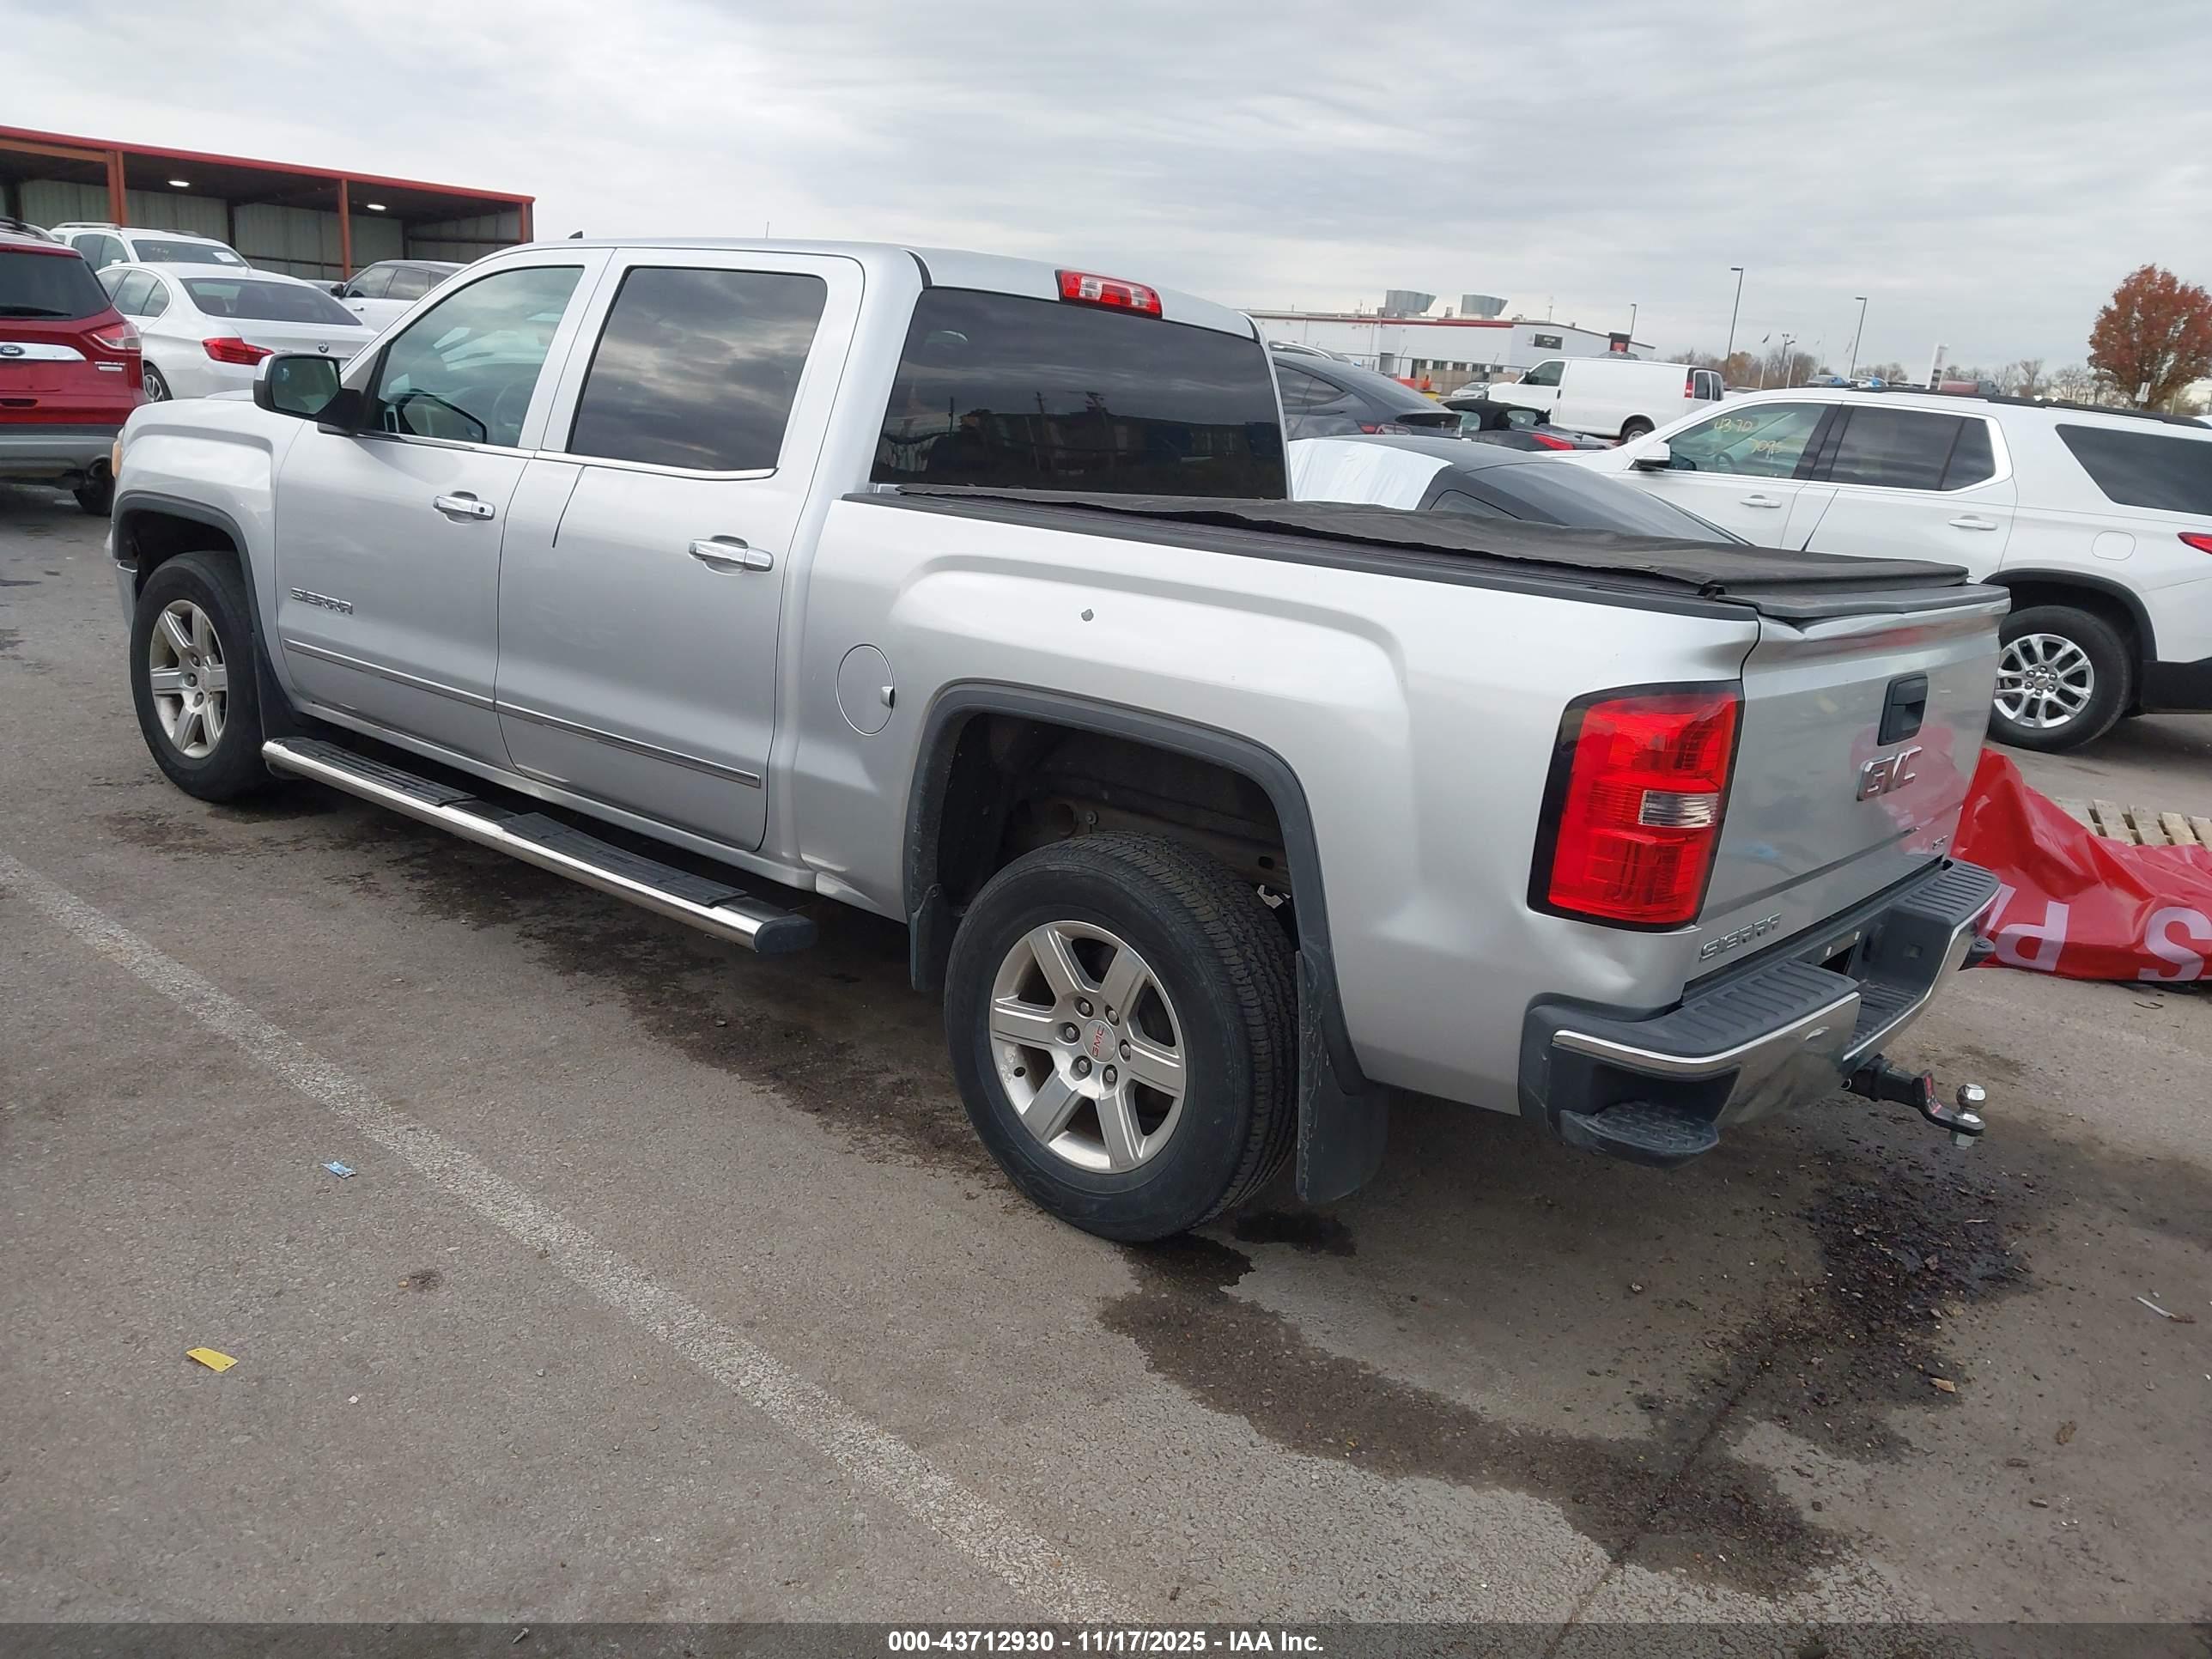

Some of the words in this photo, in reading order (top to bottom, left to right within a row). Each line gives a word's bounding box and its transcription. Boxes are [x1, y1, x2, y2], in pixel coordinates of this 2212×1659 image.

[291, 586, 353, 615] SIERRA
[1856, 745, 1923, 801] GMC
[1699, 913, 1781, 962] SIERRA
[1092, 1024, 1105, 1057] GMC
